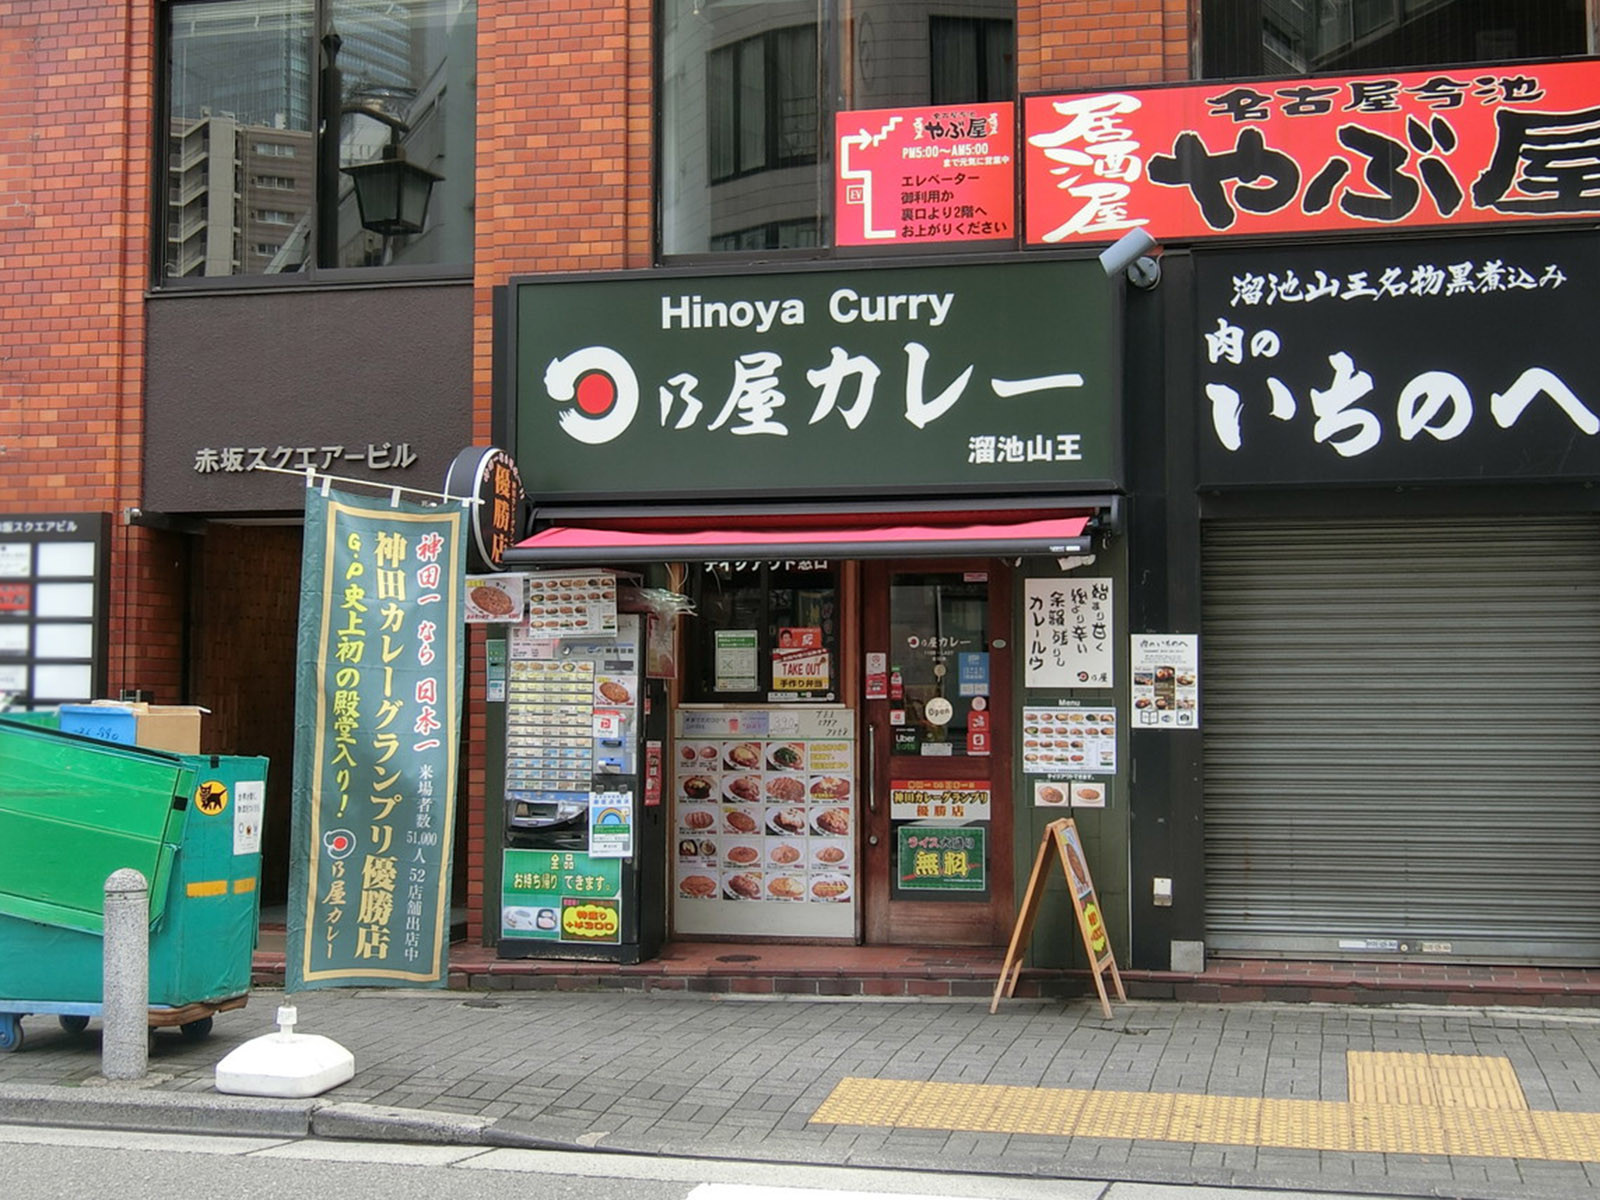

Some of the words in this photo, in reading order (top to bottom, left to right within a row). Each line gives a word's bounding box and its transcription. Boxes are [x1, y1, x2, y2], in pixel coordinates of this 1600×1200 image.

[1206, 76, 1545, 122] 名古屋今池
[924, 118, 988, 140] やぶ屋
[901, 173, 980, 187] エレベーター
[1028, 94, 1149, 243] 居酒屋
[1148, 107, 1600, 231] やぶ屋
[901, 206, 987, 221] 裏口より2階へ
[901, 222, 1007, 238] お上がりください
[1231, 260, 1567, 307] 溜池山王名物黒煮込み
[661, 295, 804, 332] Hinoya
[829, 288, 954, 326] Curry
[1205, 317, 1280, 365] 肉の
[1205, 351, 1600, 458] いちのへ
[193, 442, 418, 474] 赤坂スクエアービル
[967, 434, 1082, 464] 溜池山王
[0, 520, 78, 534] 坂スクエアビル
[782, 663, 804, 676] TAKE
[928, 708, 950, 717] Open
[354, 531, 408, 960] 神田カレーグランプリ優勝店
[896, 734, 915, 742] Uber
[915, 851, 969, 877] 無料
[513, 873, 558, 889] お持ち帰り
